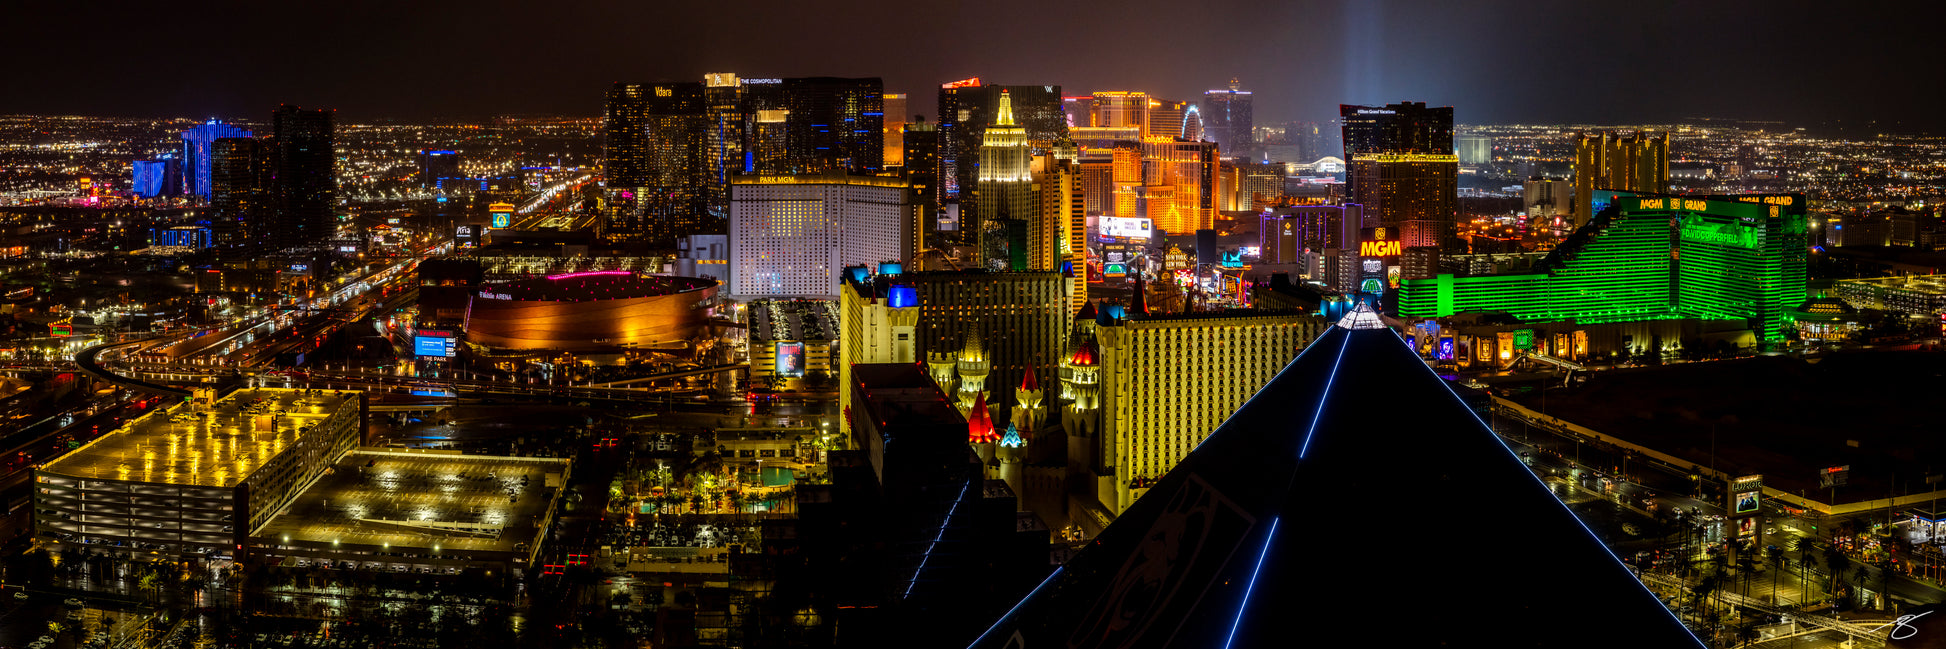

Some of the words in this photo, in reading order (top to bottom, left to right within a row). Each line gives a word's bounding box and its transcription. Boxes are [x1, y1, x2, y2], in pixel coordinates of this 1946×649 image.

[655, 86, 672, 97] Vdara
[1640, 199, 1664, 210] MGM
[1684, 199, 1707, 212] GRAND
[1764, 196, 1793, 206] GRAND
[1686, 229, 1700, 239] DAVID
[1700, 230, 1738, 244] COPPERFIELD
[1360, 241, 1402, 257] MGM
[1732, 480, 1762, 491] LUXOR
